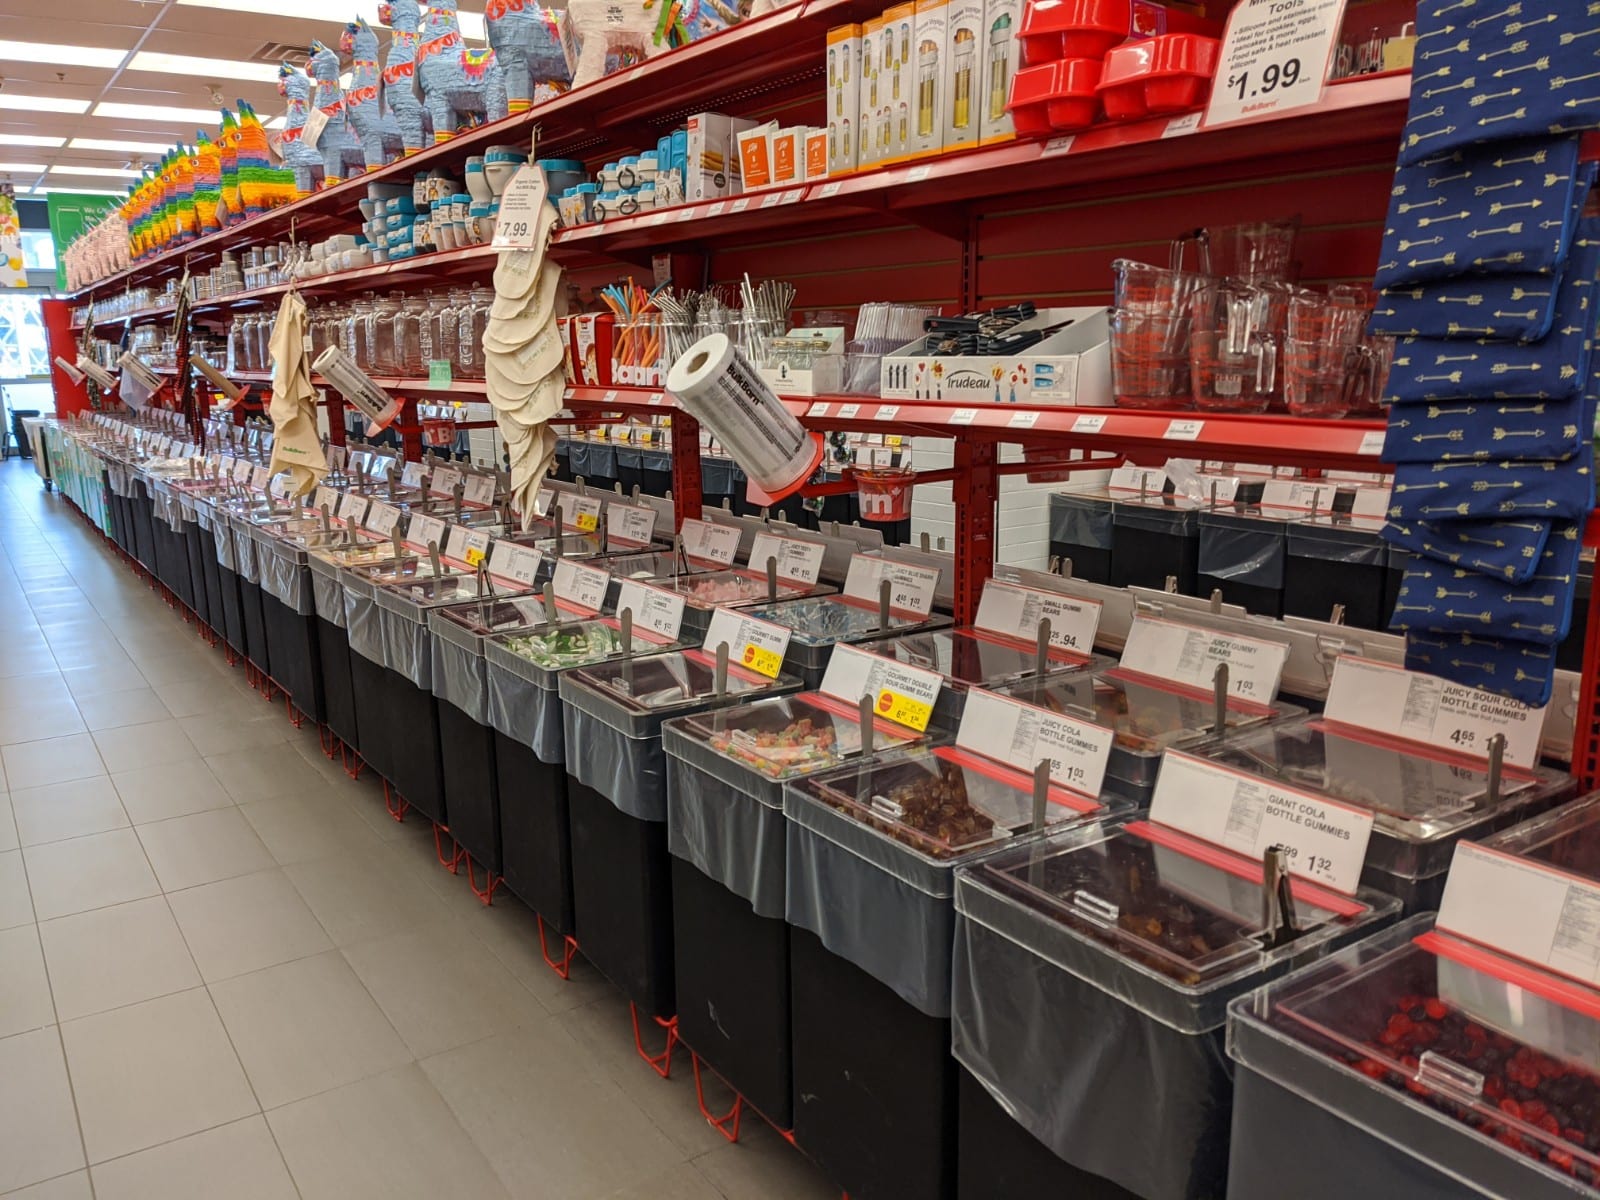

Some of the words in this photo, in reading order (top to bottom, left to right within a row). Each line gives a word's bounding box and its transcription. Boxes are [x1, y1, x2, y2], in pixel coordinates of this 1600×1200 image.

[1269, 0, 1304, 15] Tools
[1232, 52, 1250, 62] Food
[1251, 45, 1266, 56] safe
[945, 370, 990, 389] Trudeau
[1042, 606, 1060, 616] BEARS
[1044, 599, 1062, 609] SMALL
[1208, 646, 1232, 658] BEARS
[1210, 639, 1232, 649] JUICY
[1232, 643, 1258, 655] GUMMY
[887, 671, 912, 683] GOURMET
[1444, 687, 1472, 698] JUICY
[1473, 692, 1502, 705] SOUR
[1441, 695, 1479, 711] BOTTLE
[1480, 704, 1528, 722] GUMMIES
[1042, 719, 1062, 730] JUICY
[1062, 725, 1081, 737] COLA
[1039, 727, 1066, 742] BOTTLE
[1066, 736, 1099, 753] GUMMIES
[1268, 795, 1299, 810] GIANT
[1299, 804, 1326, 820] COLA
[1266, 805, 1303, 824] BOTTLE
[1304, 818, 1351, 841] GUMMIES
